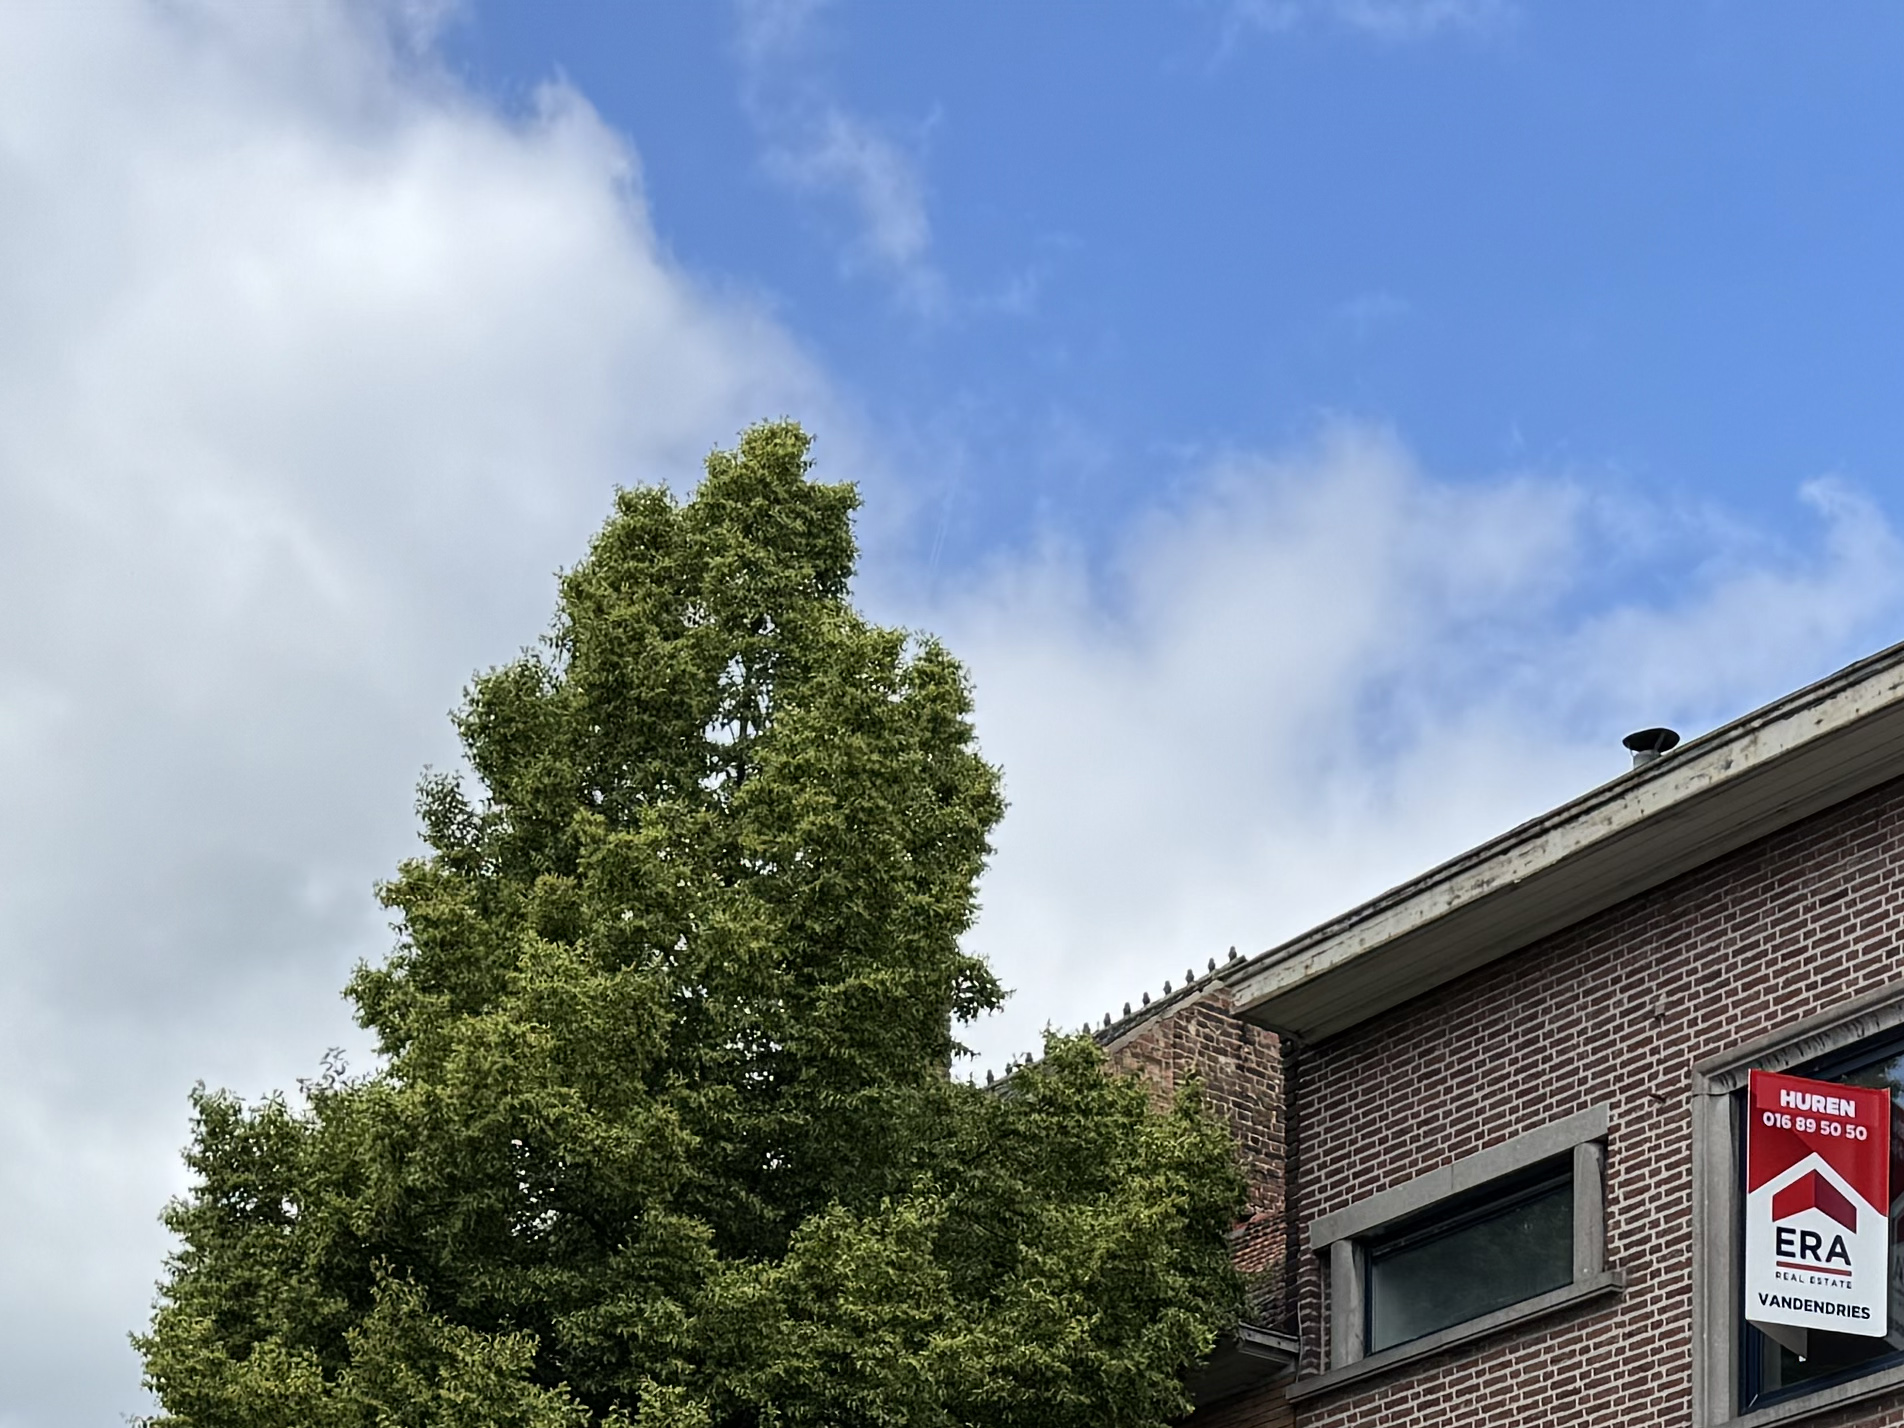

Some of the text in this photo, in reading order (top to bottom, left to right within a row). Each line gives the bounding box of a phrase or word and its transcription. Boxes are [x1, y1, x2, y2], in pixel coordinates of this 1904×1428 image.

[1780, 1089, 1856, 1118] HUREN
[1762, 1111, 1868, 1141] 016 89 50 50
[1776, 1226, 1852, 1266] ERA
[1775, 1271, 1852, 1289] REAL ESTATE
[1758, 1292, 1871, 1320] VANDENDRIES
